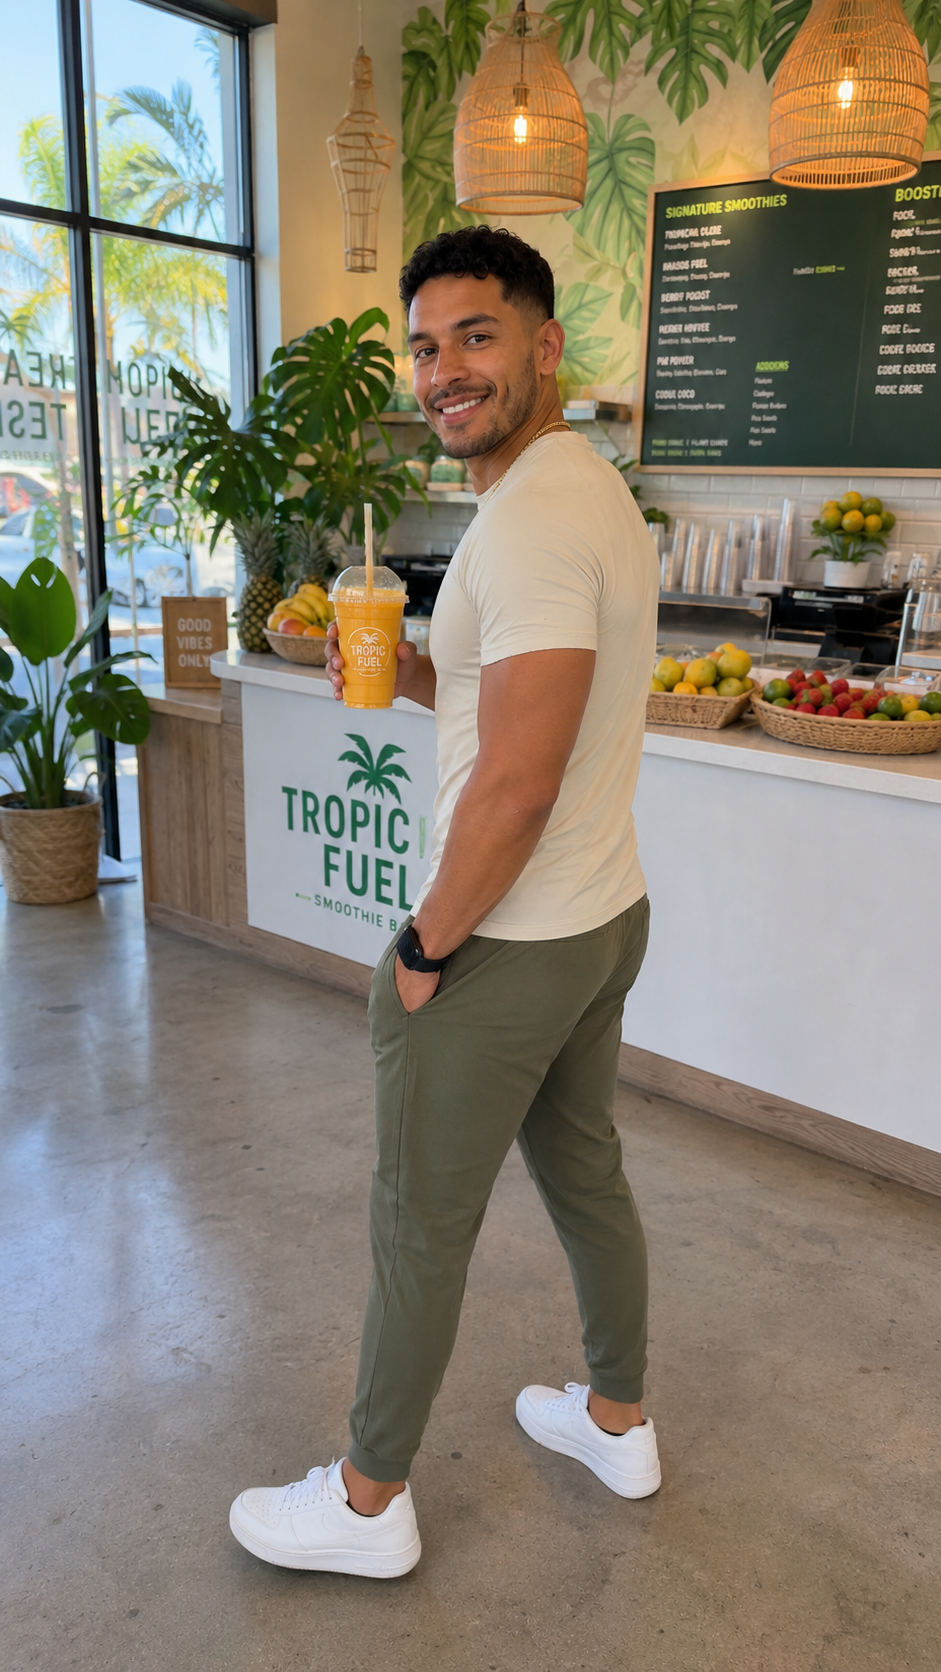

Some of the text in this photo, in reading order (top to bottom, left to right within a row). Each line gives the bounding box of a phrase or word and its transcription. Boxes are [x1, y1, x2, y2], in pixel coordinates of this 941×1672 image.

[665, 194, 788, 219] SIGNATURE SMOOTHIES
[177, 618, 212, 632] GOOD
[176, 636, 213, 650] VIBES
[350, 645, 386, 656] TROPIC
[178, 653, 211, 668] ONLY
[357, 656, 382, 667] FUEL
[281, 785, 410, 854] TROPIC
[324, 843, 413, 912] FUEL
[314, 894, 404, 932] SMOOTHIE B
